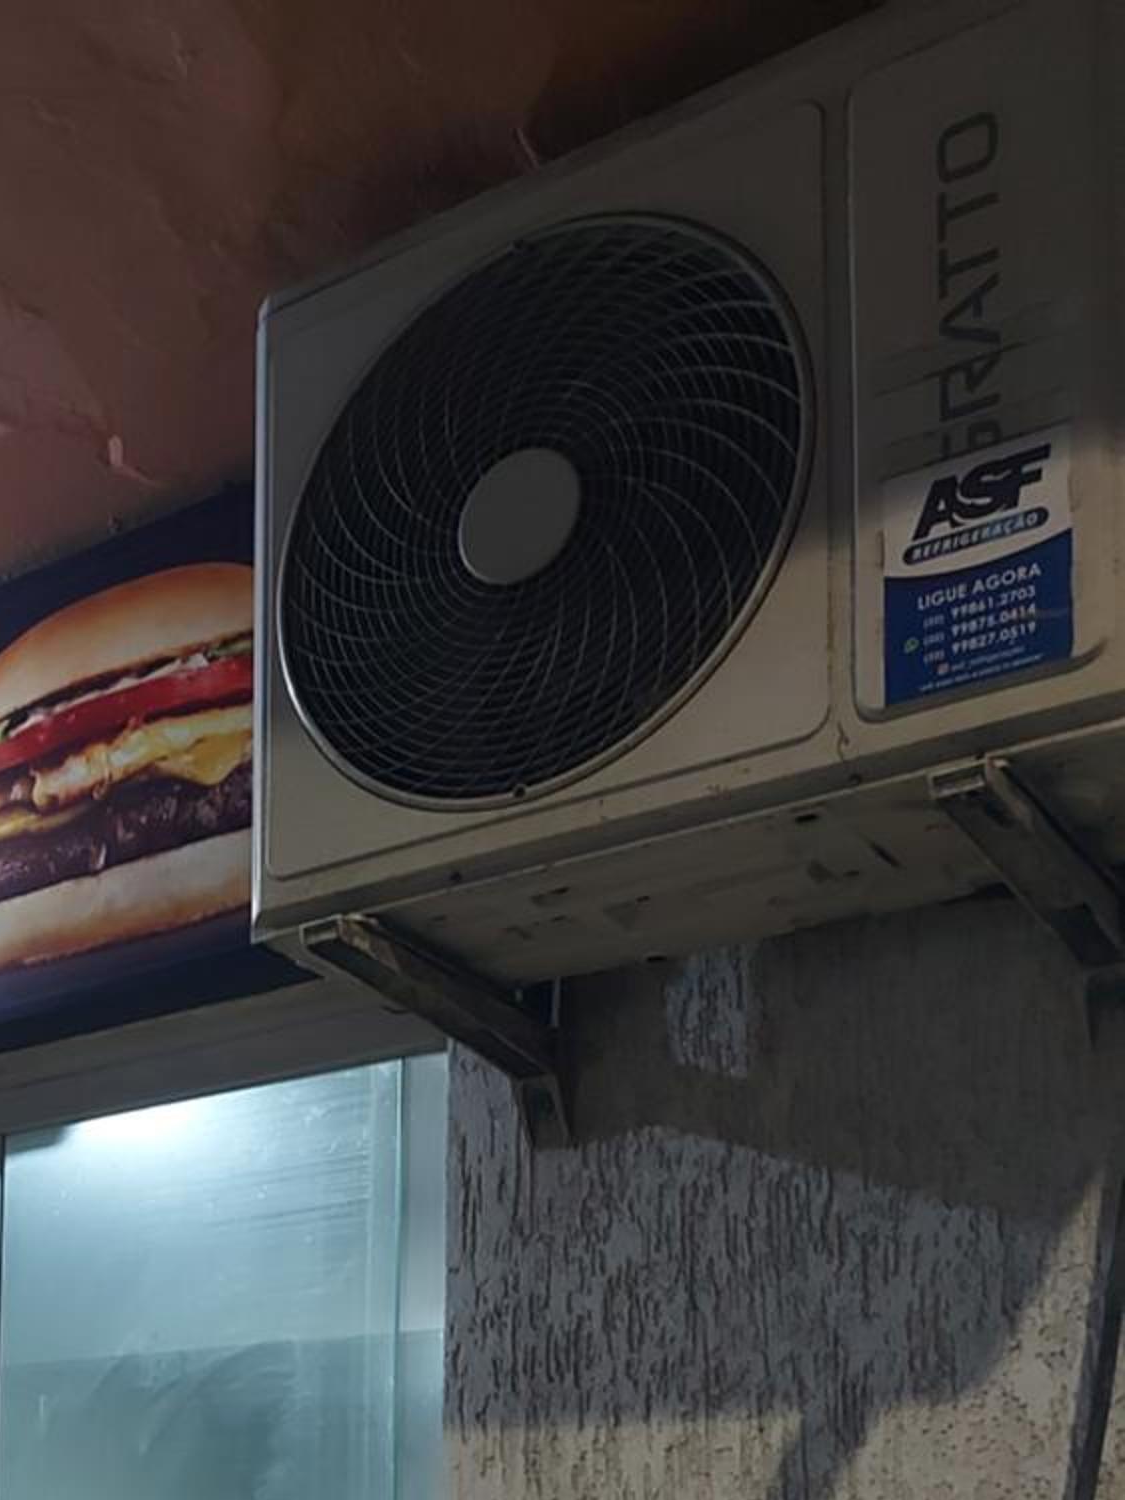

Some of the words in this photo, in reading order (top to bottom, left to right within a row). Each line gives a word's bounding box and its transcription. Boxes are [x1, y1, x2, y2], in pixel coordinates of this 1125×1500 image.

[912, 443, 1051, 541] ASF
[910, 510, 1041, 561] REFRIGERAÇÃO
[917, 583, 969, 611] LIGUE
[971, 563, 1042, 594] AGORA
